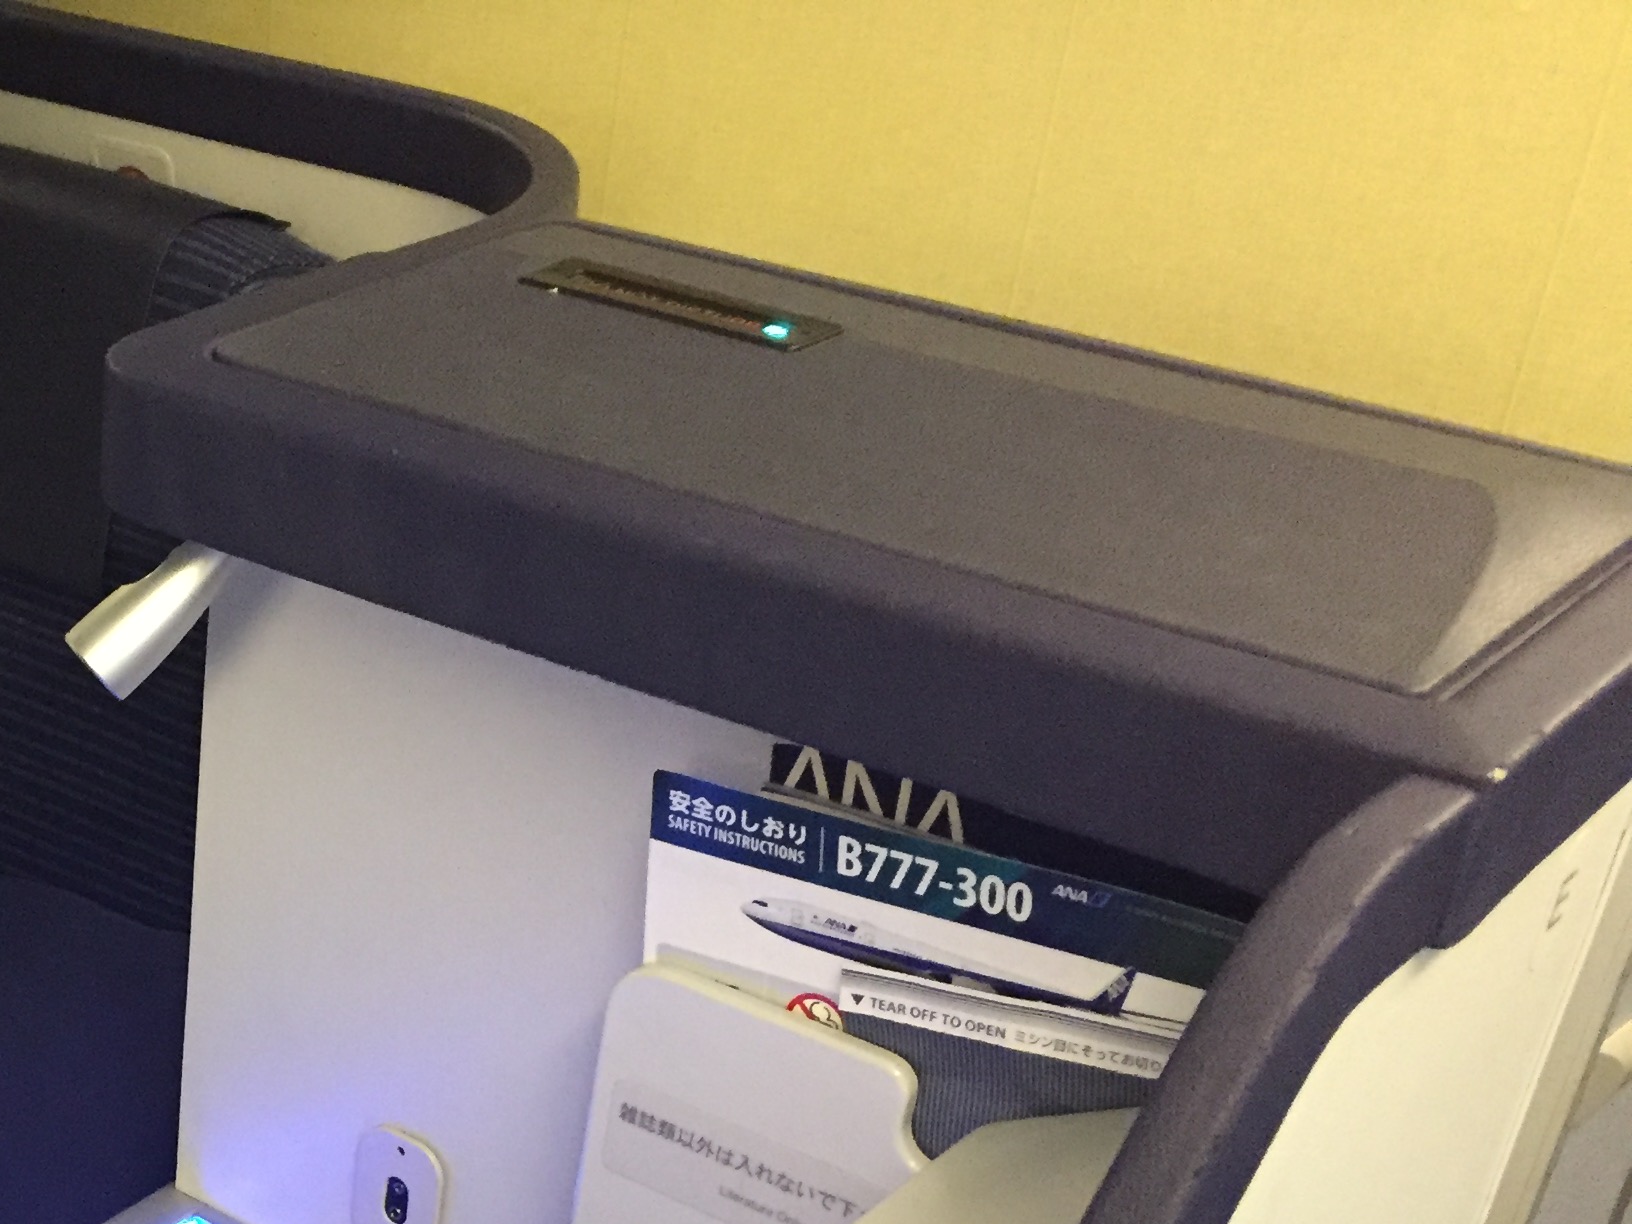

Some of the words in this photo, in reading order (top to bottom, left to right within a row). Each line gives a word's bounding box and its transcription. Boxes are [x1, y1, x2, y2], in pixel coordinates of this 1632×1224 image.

[668, 789, 807, 846] 安全のしおり
[783, 744, 965, 844] ANA
[668, 814, 713, 838] SAFETY
[713, 827, 806, 864] INSTRUCTIONS
[837, 834, 1034, 922] B777-300
[1051, 884, 1089, 904] ANA
[870, 996, 907, 1015] TEAR
[909, 1006, 938, 1022] OFF
[941, 1013, 962, 1028] TO
[964, 1019, 1008, 1039] OPEN
[618, 1101, 869, 1219] 雑誌類以外は入れないで下
